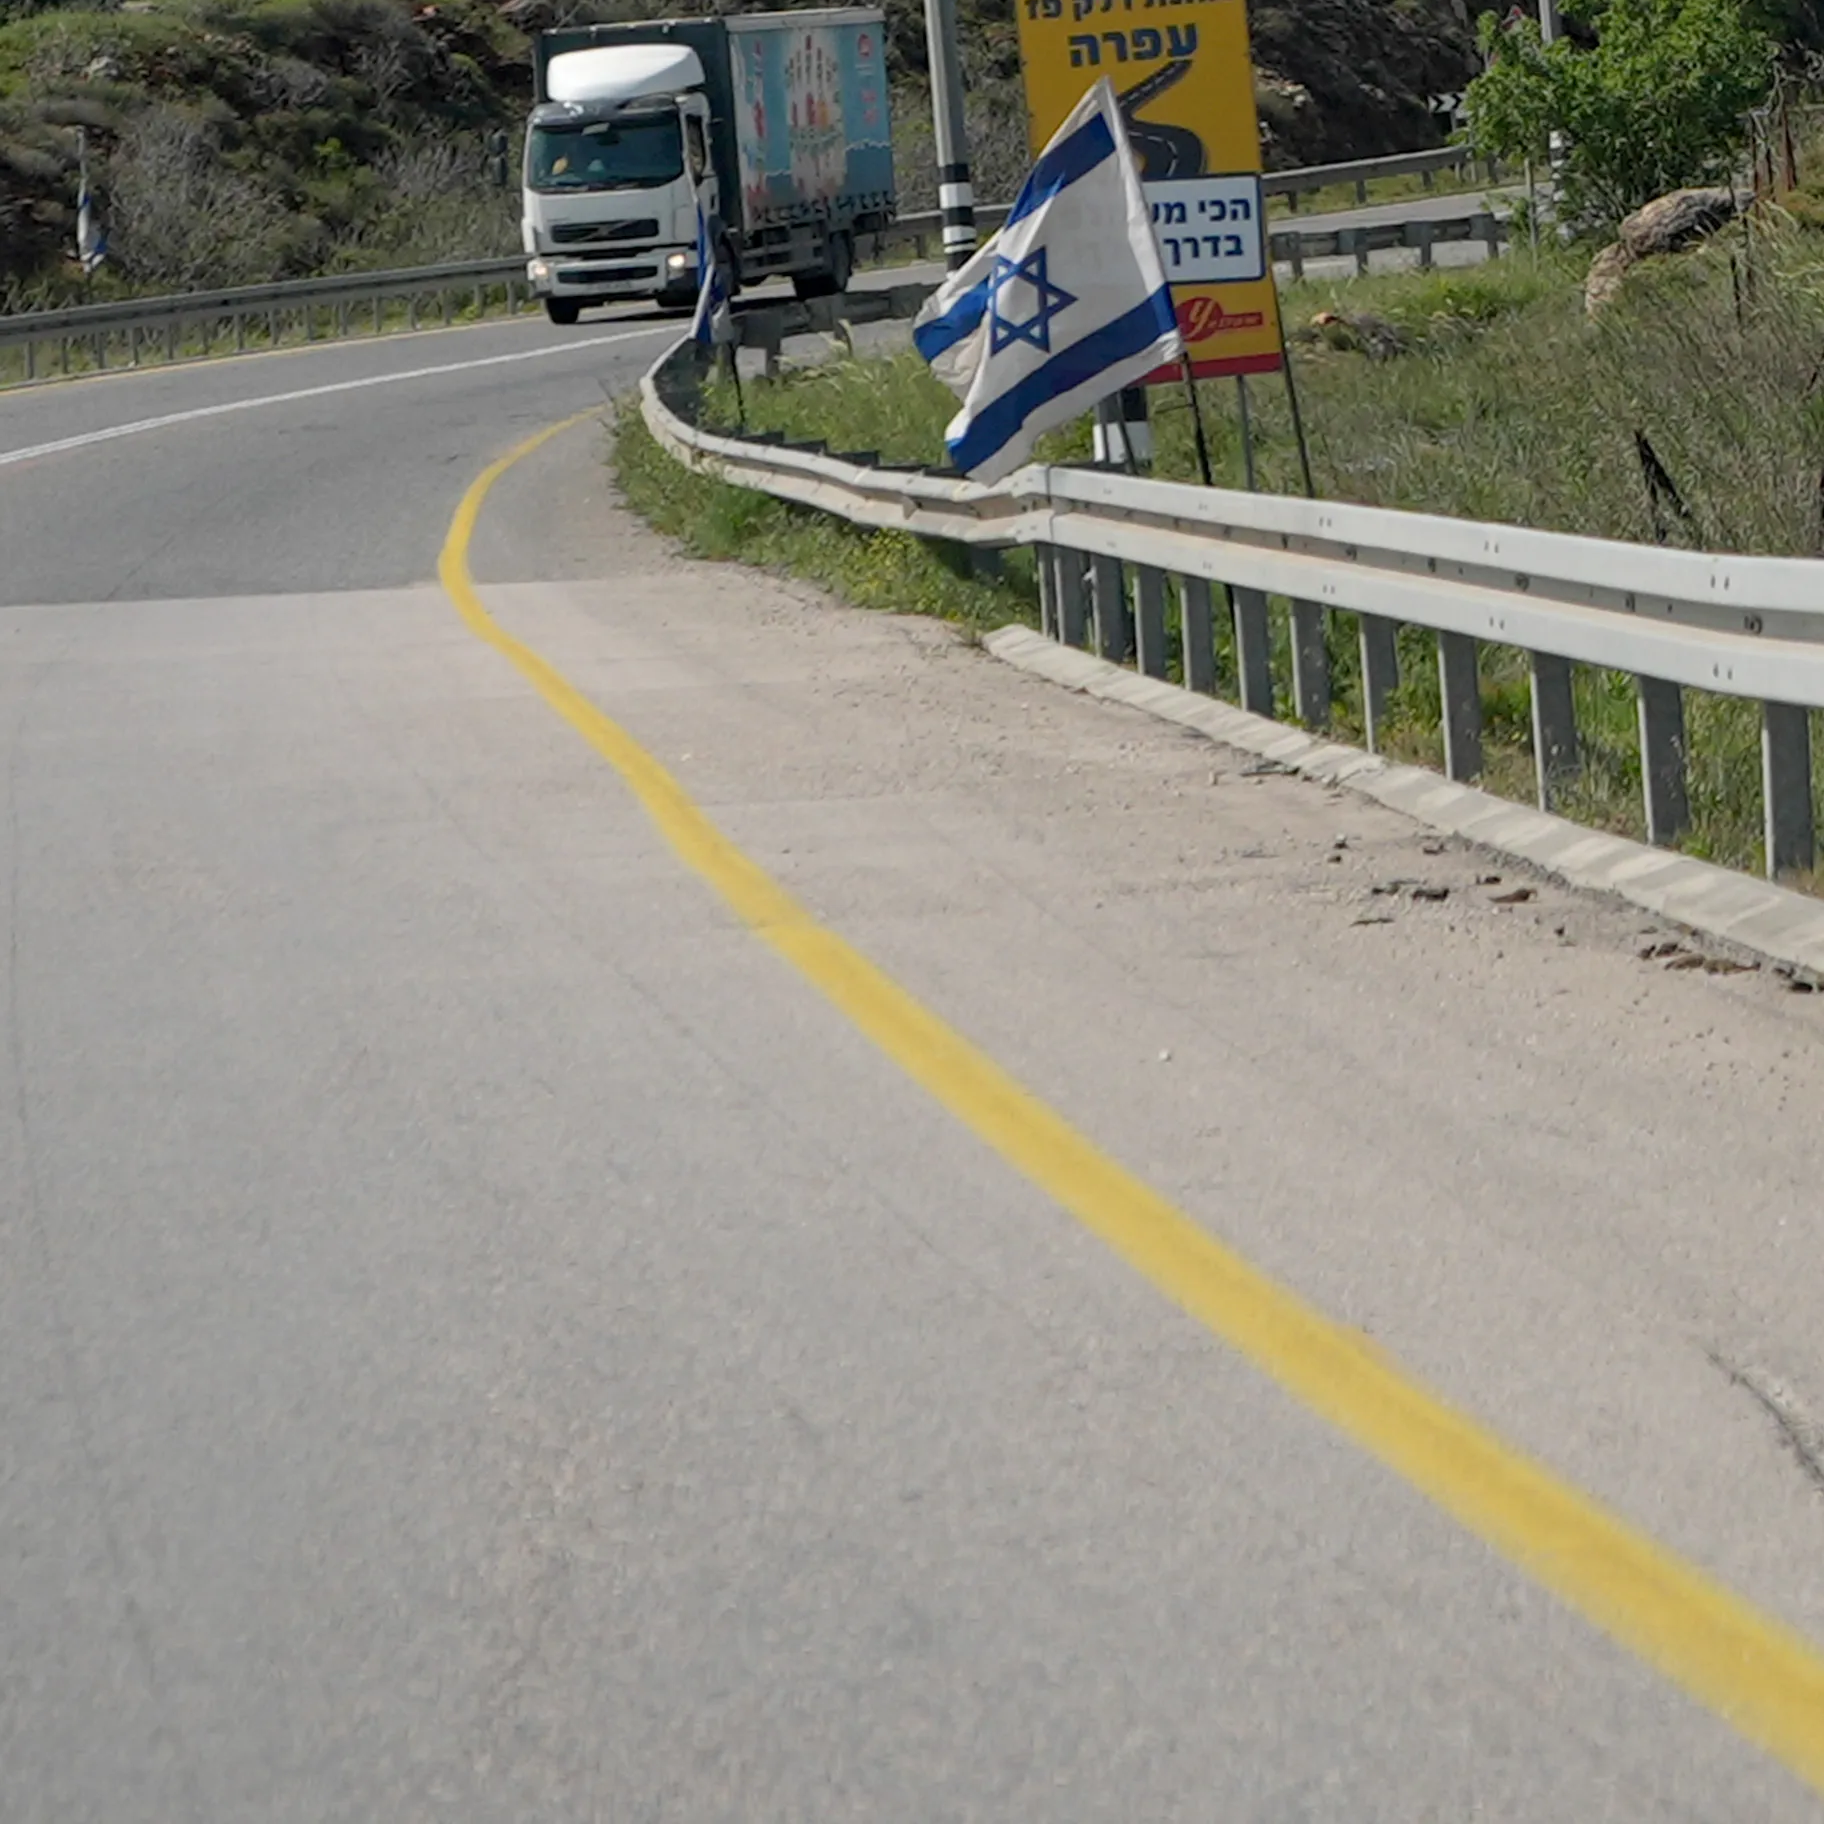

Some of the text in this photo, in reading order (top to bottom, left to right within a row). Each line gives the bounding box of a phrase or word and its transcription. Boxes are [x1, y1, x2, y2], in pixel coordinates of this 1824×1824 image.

[1067, 22, 1199, 68] עפרה
[1197, 198, 1251, 223] הכי
[1163, 234, 1244, 266] בדרך
